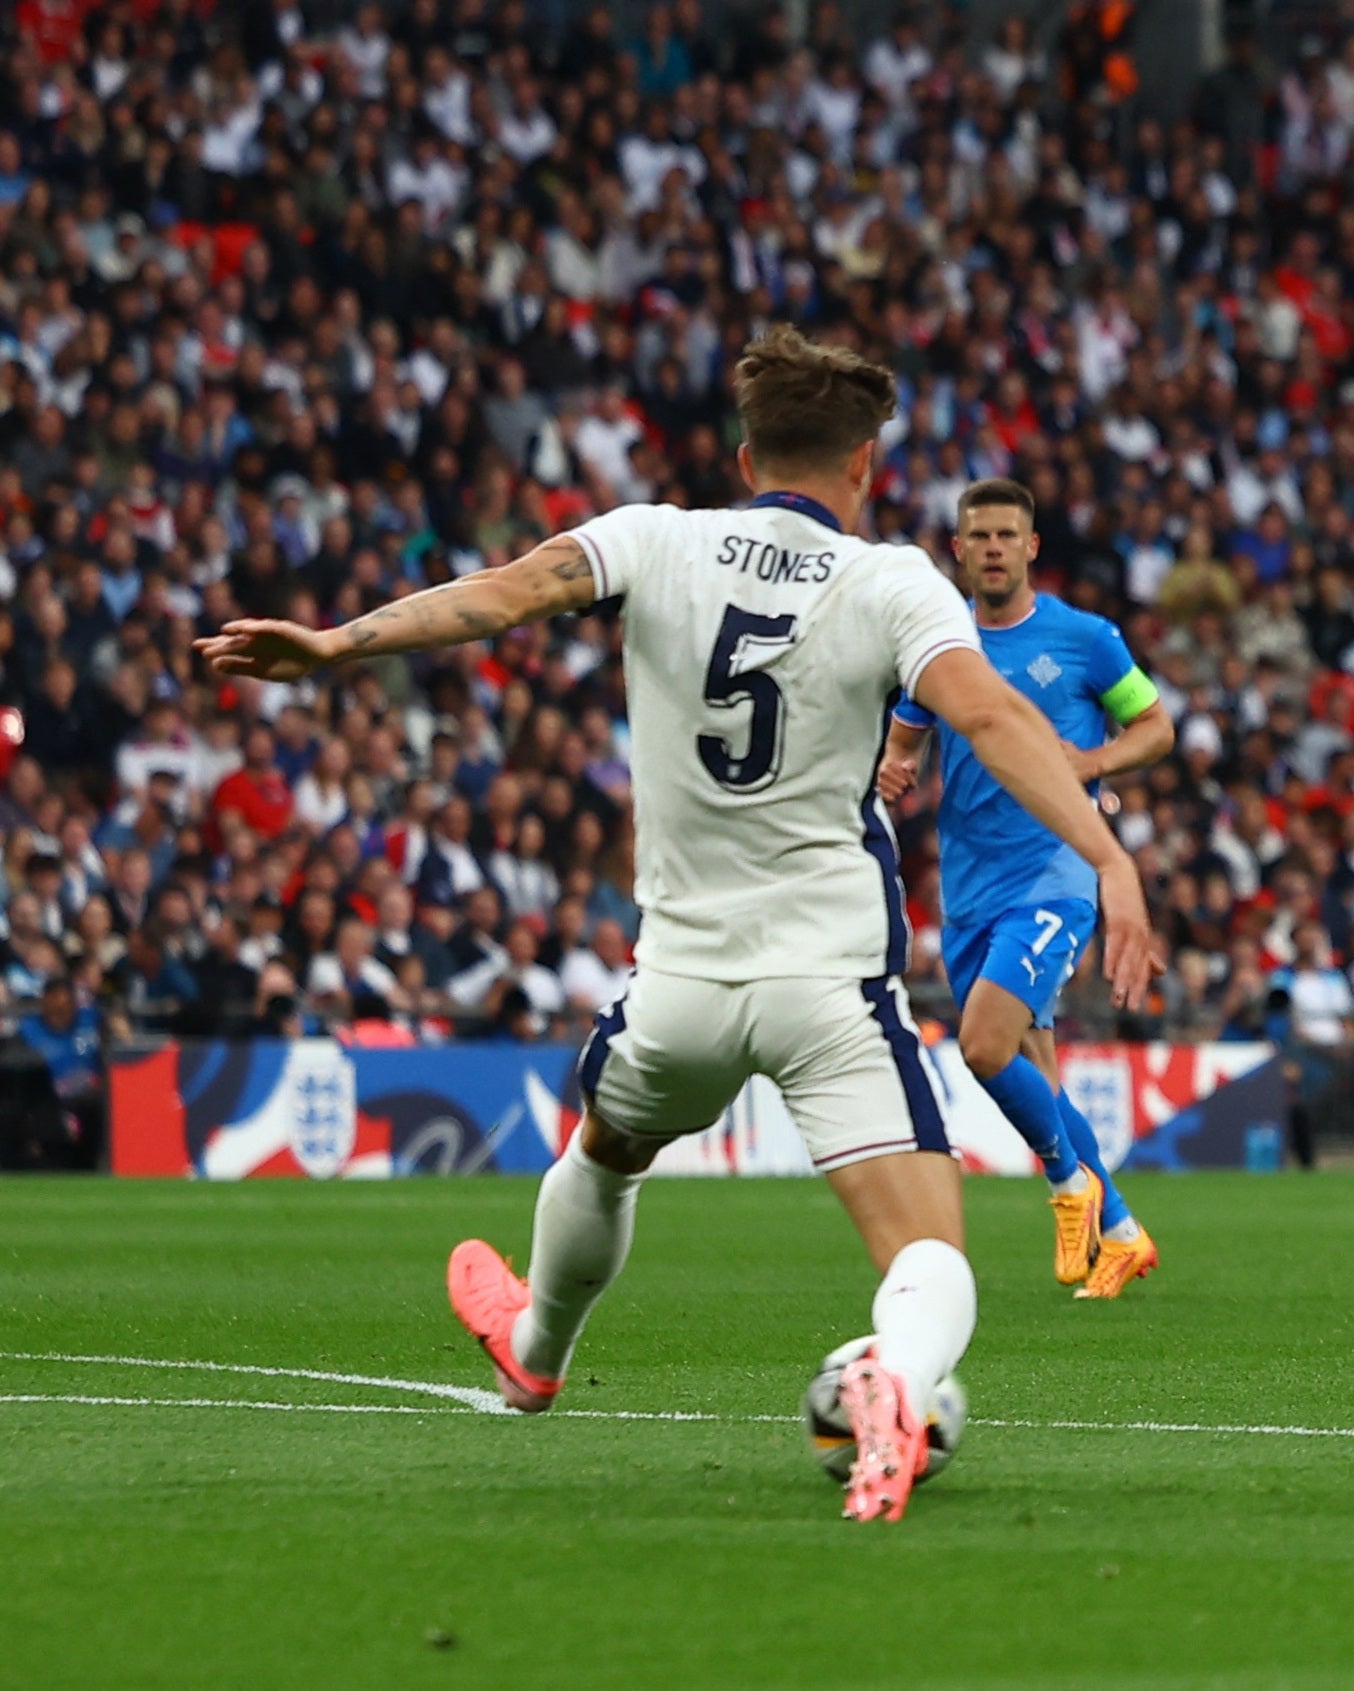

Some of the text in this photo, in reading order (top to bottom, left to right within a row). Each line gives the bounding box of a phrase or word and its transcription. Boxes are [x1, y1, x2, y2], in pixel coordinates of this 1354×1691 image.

[717, 535, 835, 584] STONES
[696, 603, 797, 794] 5
[1032, 908, 1063, 956] 7
